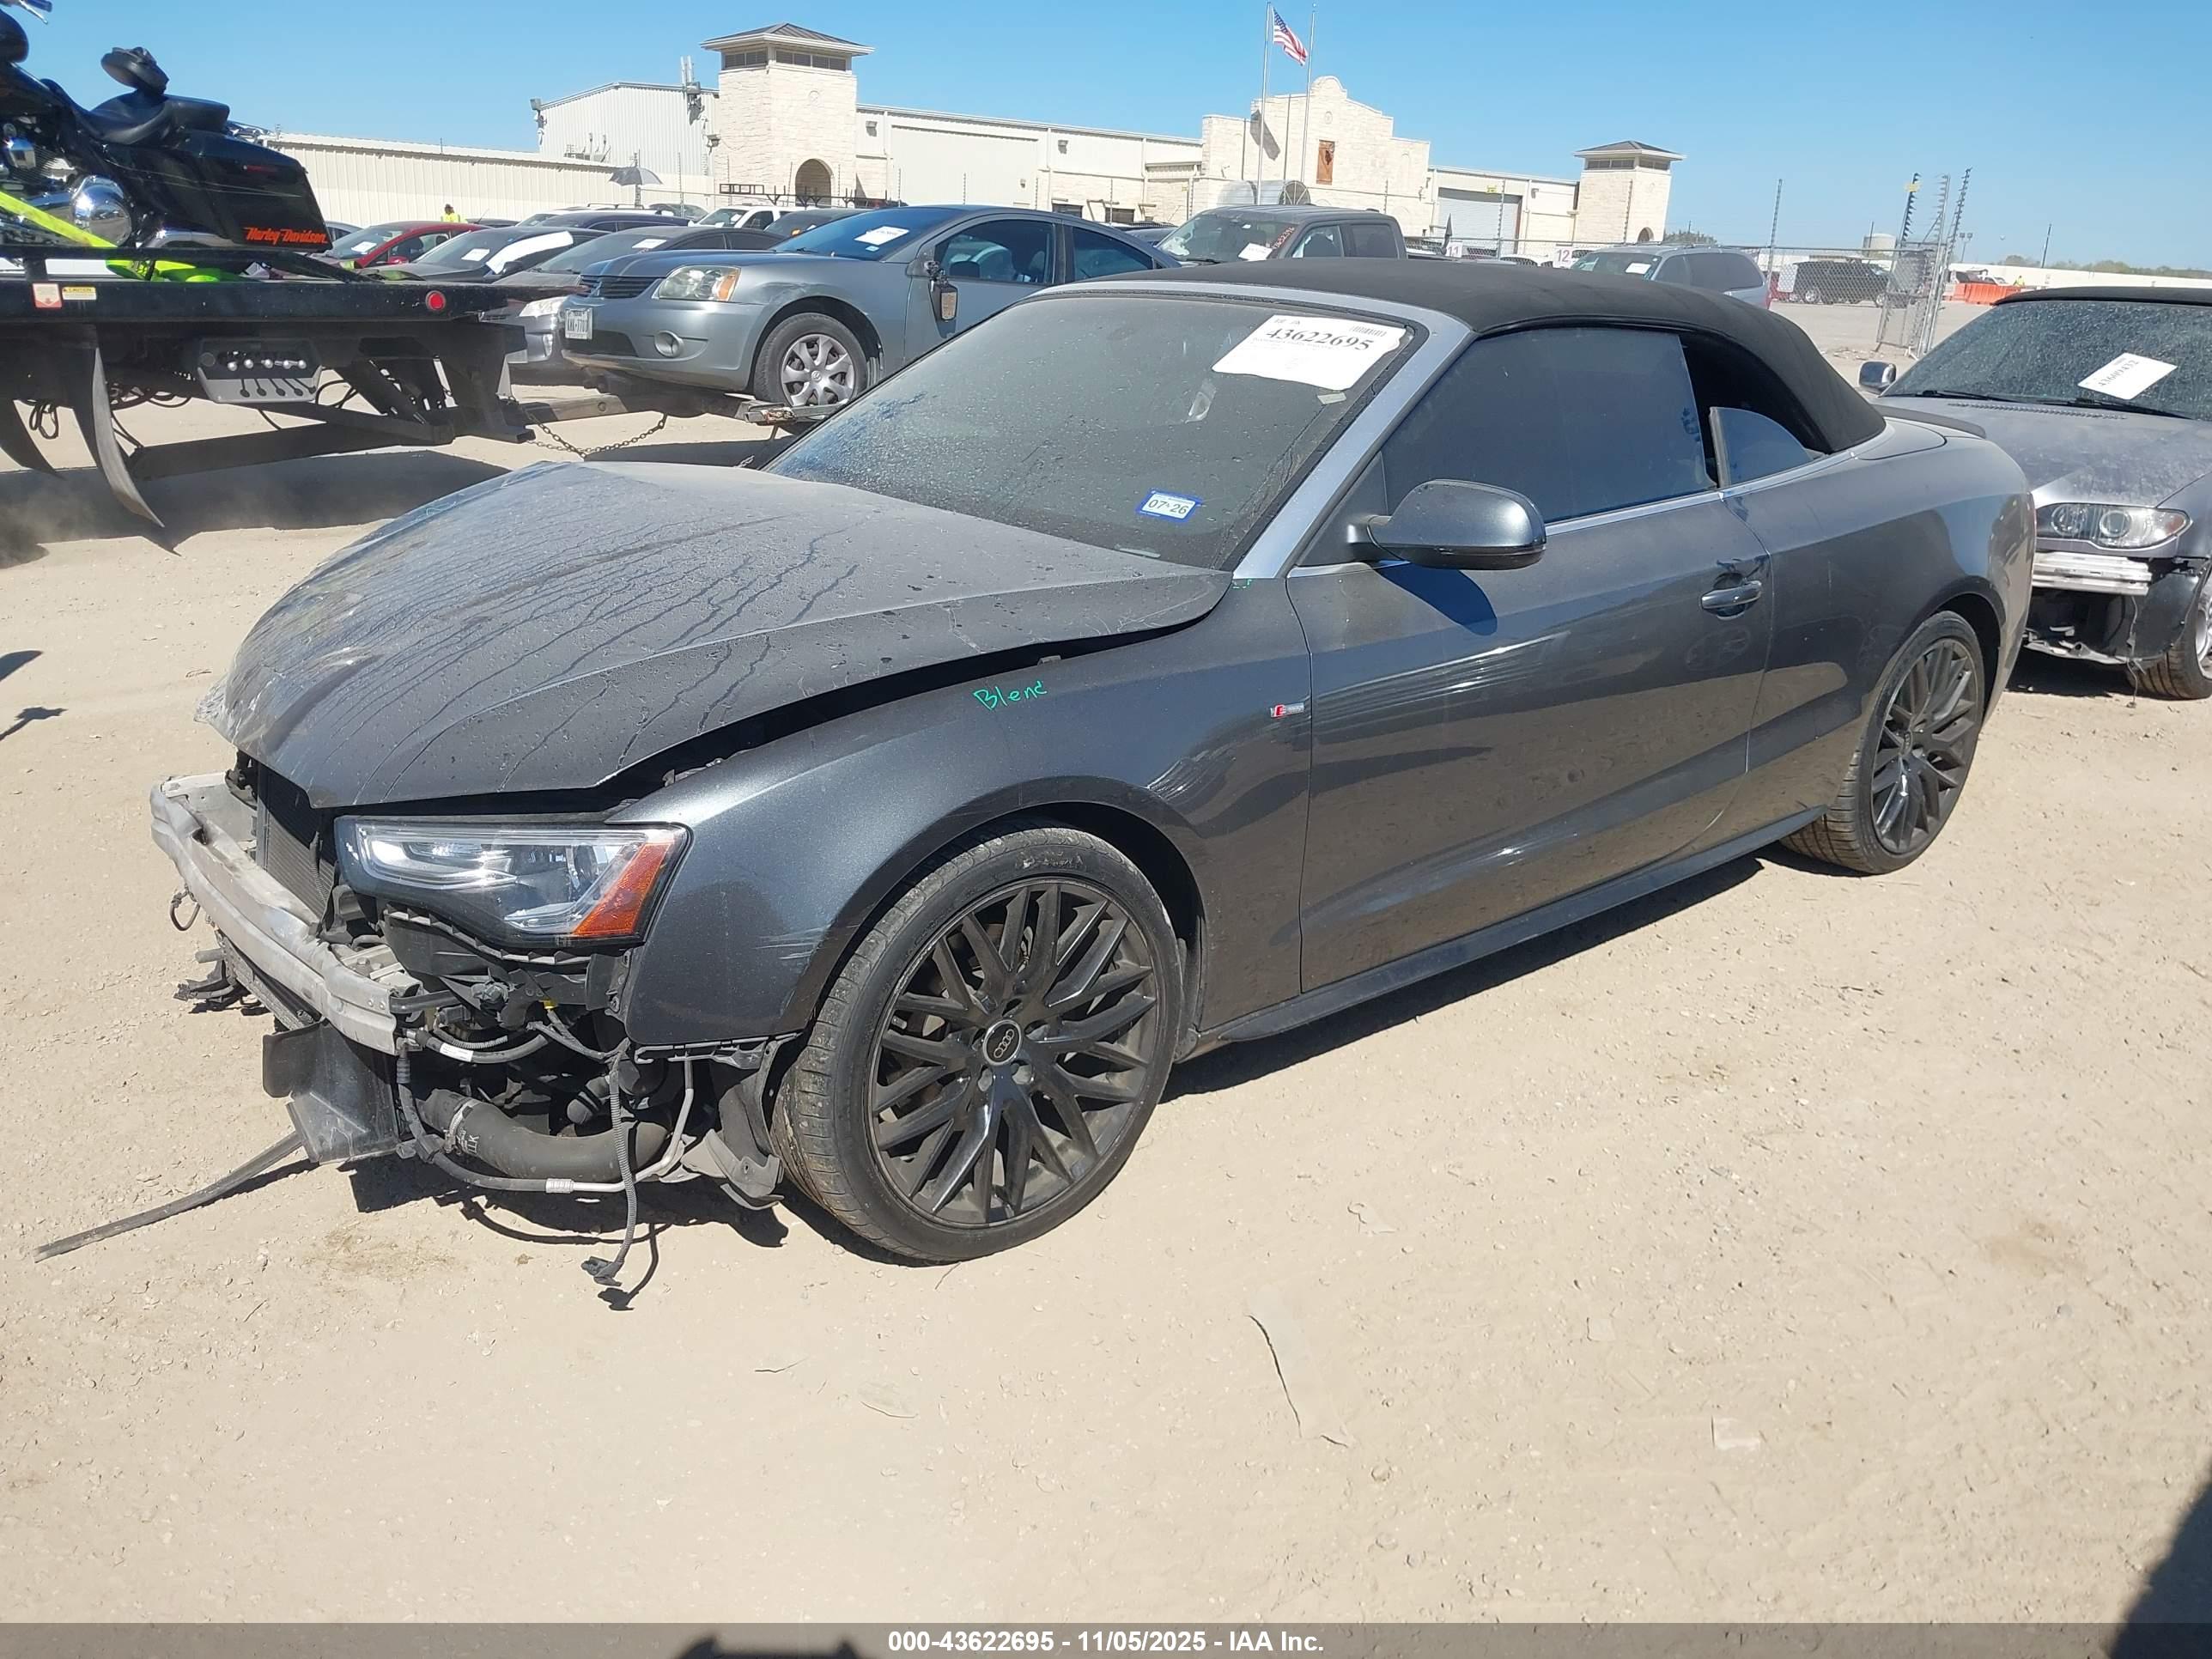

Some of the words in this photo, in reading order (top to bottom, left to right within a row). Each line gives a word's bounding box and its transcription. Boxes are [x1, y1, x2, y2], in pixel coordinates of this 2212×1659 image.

[1557, 250, 1571, 263] 12
[1266, 328, 1374, 350] 43622695
[973, 680, 1048, 711] Blend
